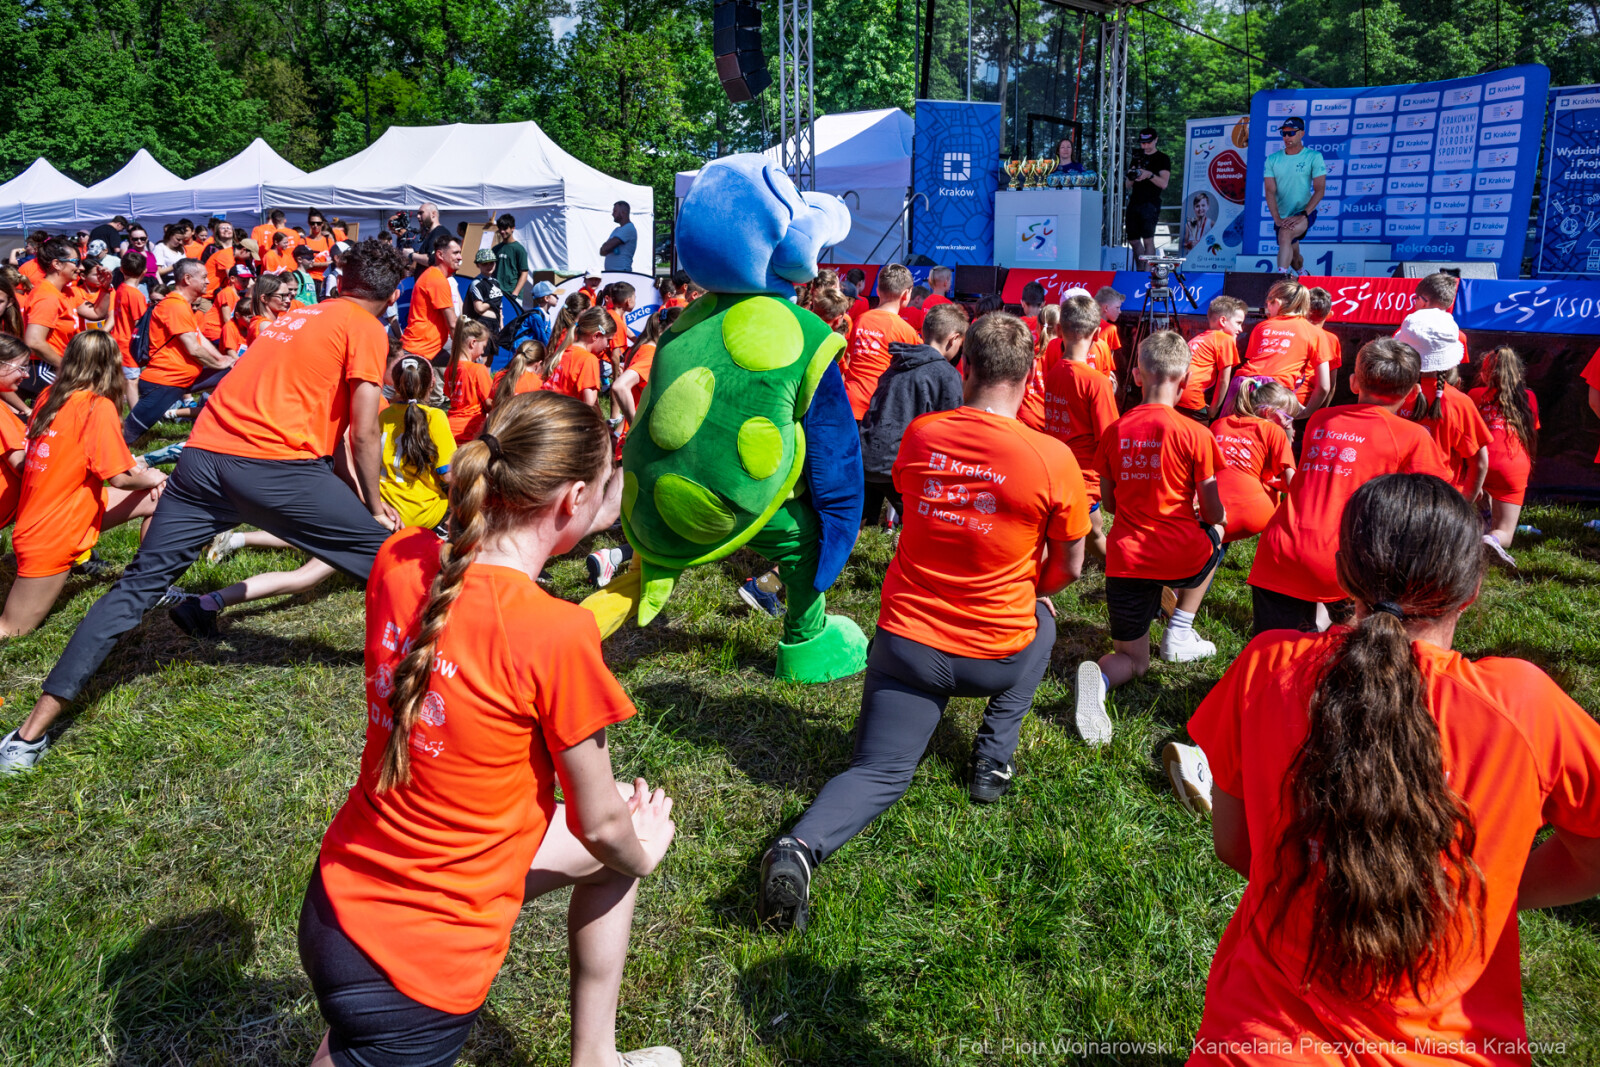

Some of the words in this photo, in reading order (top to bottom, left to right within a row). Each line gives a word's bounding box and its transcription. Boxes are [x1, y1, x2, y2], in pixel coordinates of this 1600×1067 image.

[1497, 84, 1521, 93] Kraków
[1442, 112, 1477, 125] KRAKOWSKI
[1441, 124, 1475, 136] SZKOLNY
[1440, 135, 1474, 147] OŚRODEK
[1307, 143, 1347, 152] SPORT
[1438, 145, 1474, 157] SPORTOWY
[1557, 146, 1600, 158] Wydział
[1571, 159, 1575, 168] i
[1577, 158, 1600, 169] Proj
[939, 187, 975, 197] Kraków
[1343, 202, 1382, 213] Nauka
[1396, 242, 1455, 255] Rekreacja
[1316, 250, 1334, 277] 1
[1373, 292, 1416, 312] KSOS
[626, 307, 651, 322] życie
[1225, 436, 1253, 446] Kraków
[1325, 430, 1366, 443] Kraków
[1133, 439, 1162, 448] Kraków
[950, 459, 1006, 485] Kraków
[1312, 464, 1333, 473] MCPU
[1131, 472, 1149, 480] MCPU
[932, 508, 965, 526] MCPU
